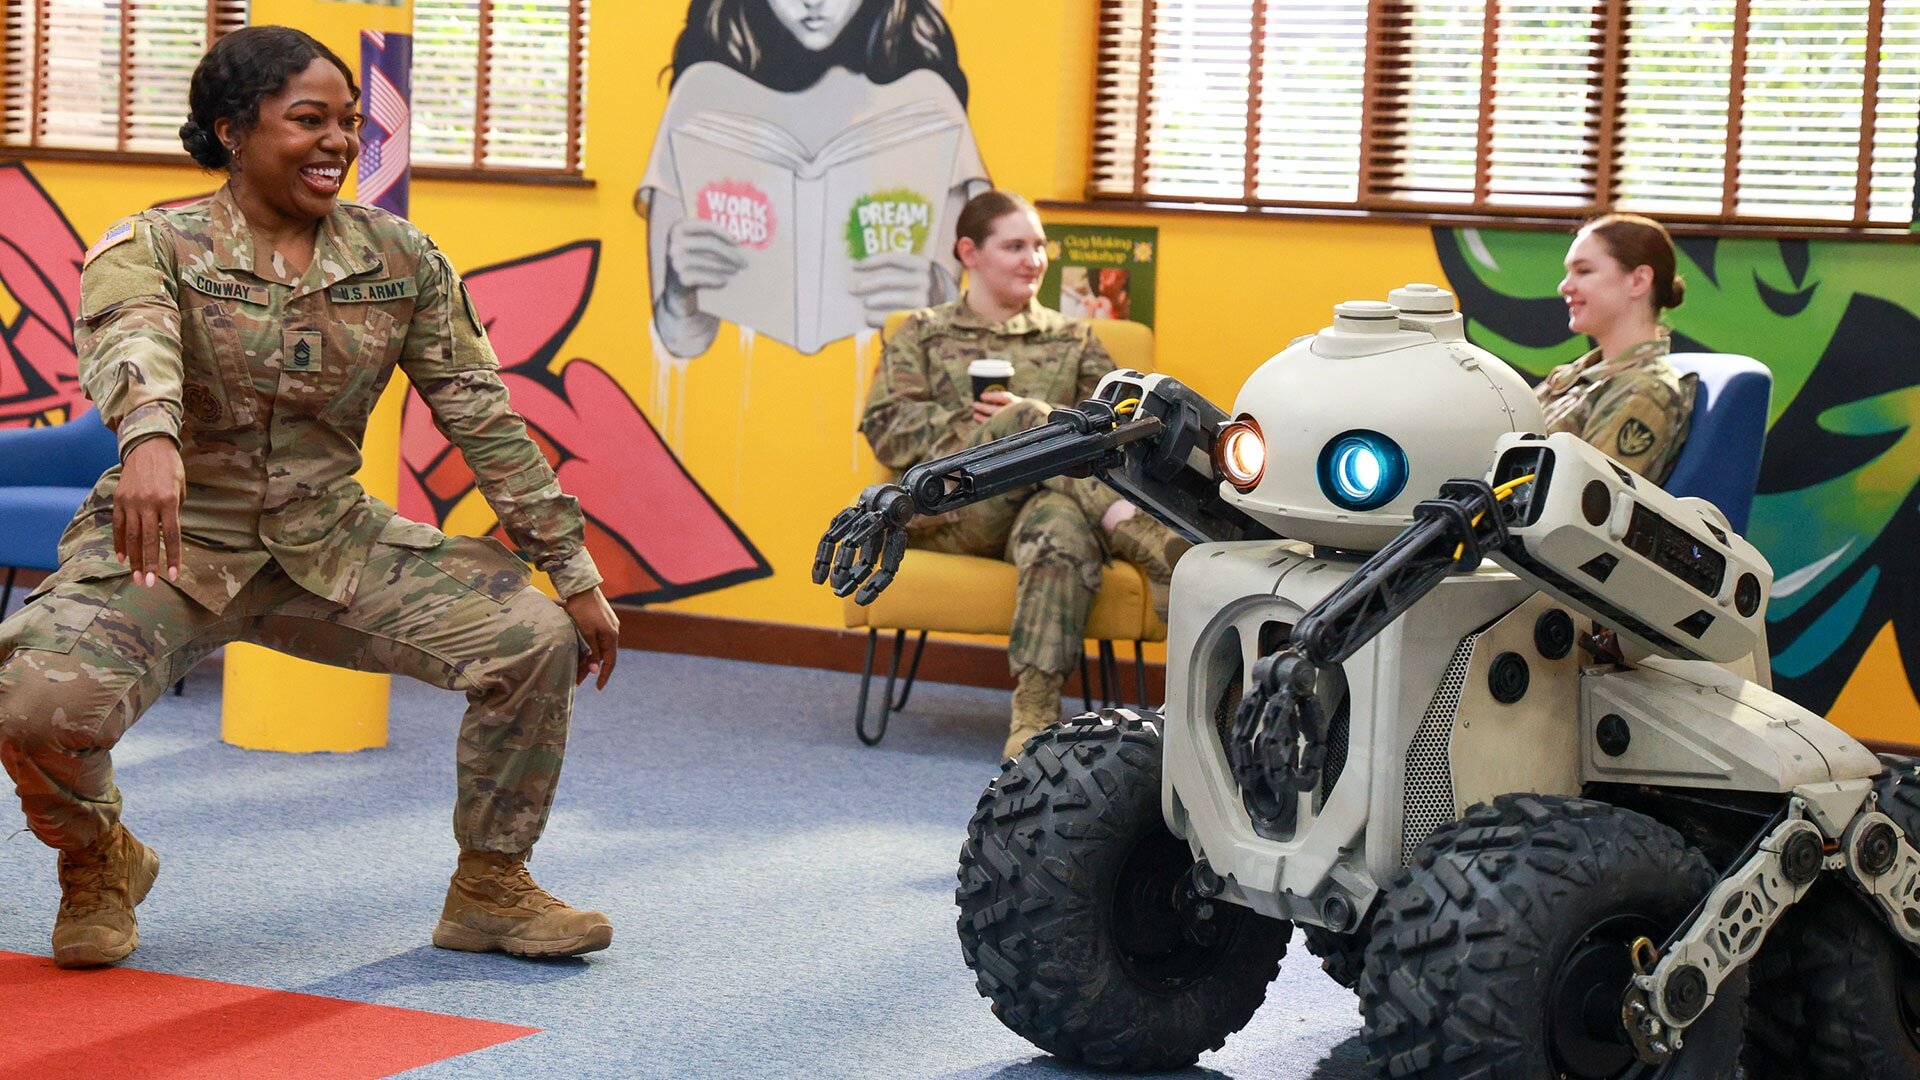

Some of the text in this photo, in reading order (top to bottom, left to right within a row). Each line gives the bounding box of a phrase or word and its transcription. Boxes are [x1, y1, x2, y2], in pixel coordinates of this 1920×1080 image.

[705, 190, 768, 223] WORK
[858, 201, 928, 227] DREAM
[863, 226, 912, 254] BIG
[1090, 235, 1133, 251] Making
[1068, 250, 1127, 264] Workshop
[196, 275, 250, 299] CONWAY
[368, 281, 405, 299] ARMY
